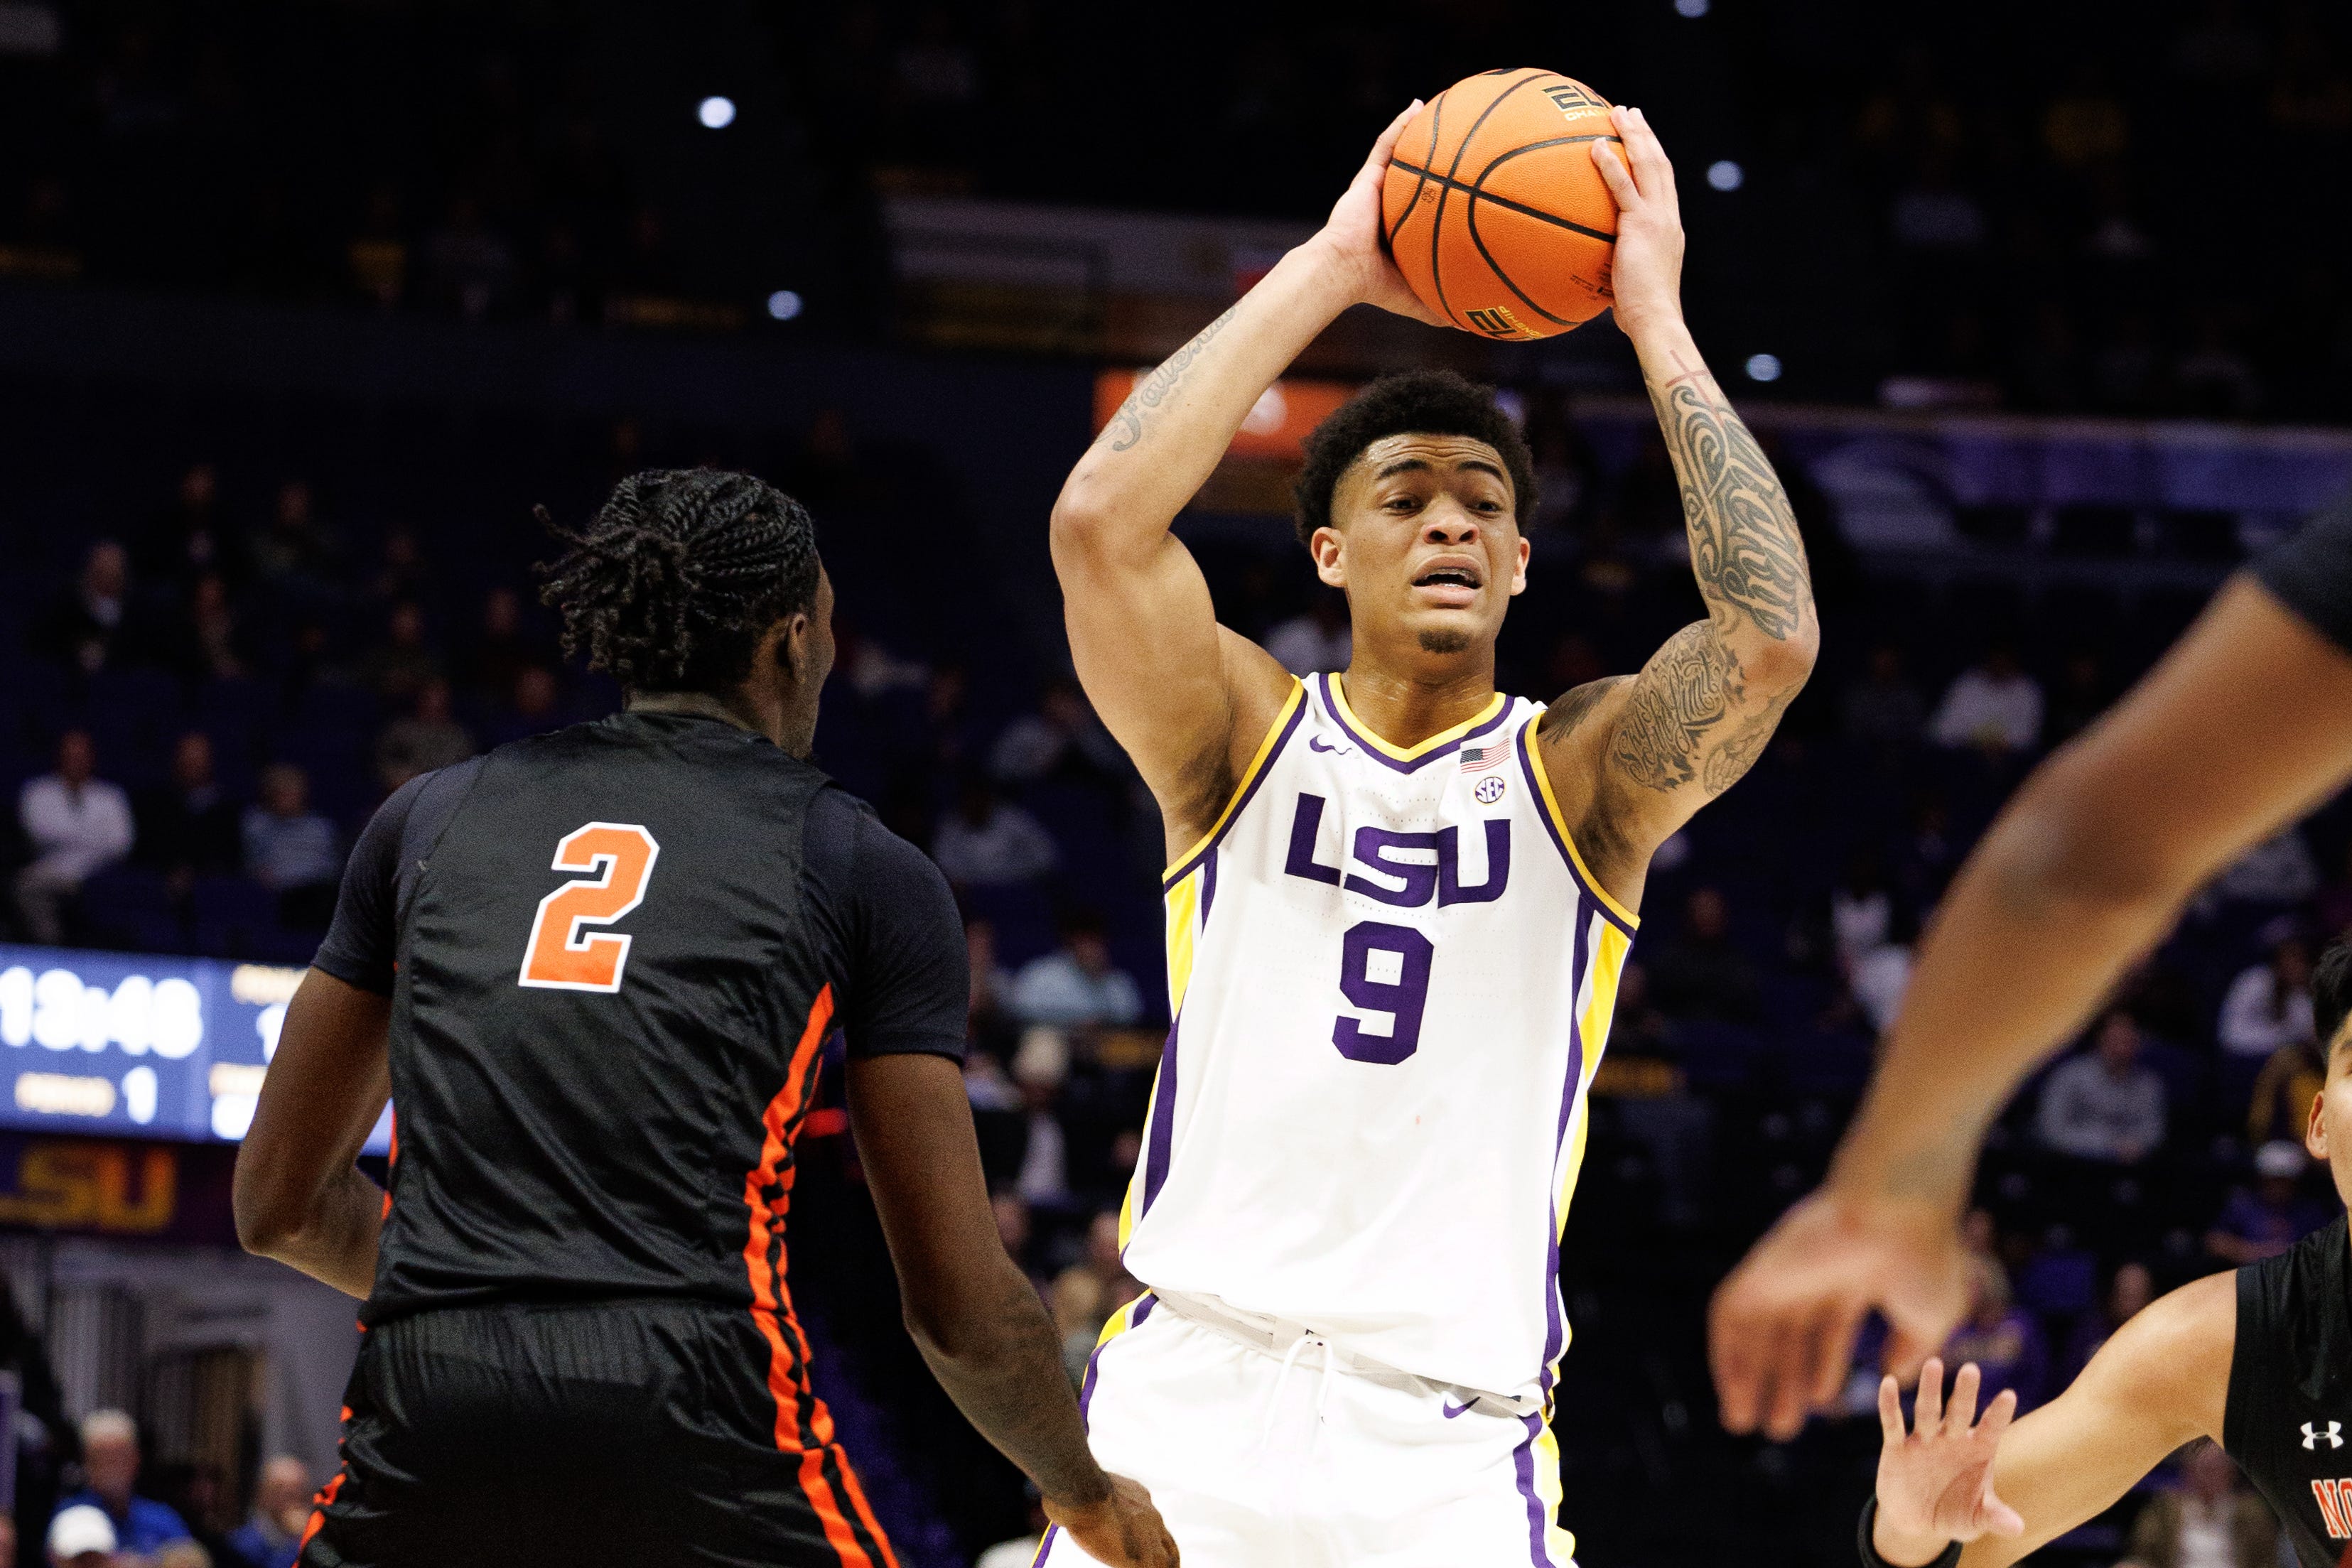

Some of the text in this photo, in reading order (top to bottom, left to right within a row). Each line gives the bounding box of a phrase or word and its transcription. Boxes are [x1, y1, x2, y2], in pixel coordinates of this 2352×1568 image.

[1284, 791, 1511, 909] LSU
[1474, 777, 1505, 804] SEC
[518, 821, 661, 994] 2
[1332, 920, 1435, 1066] 9
